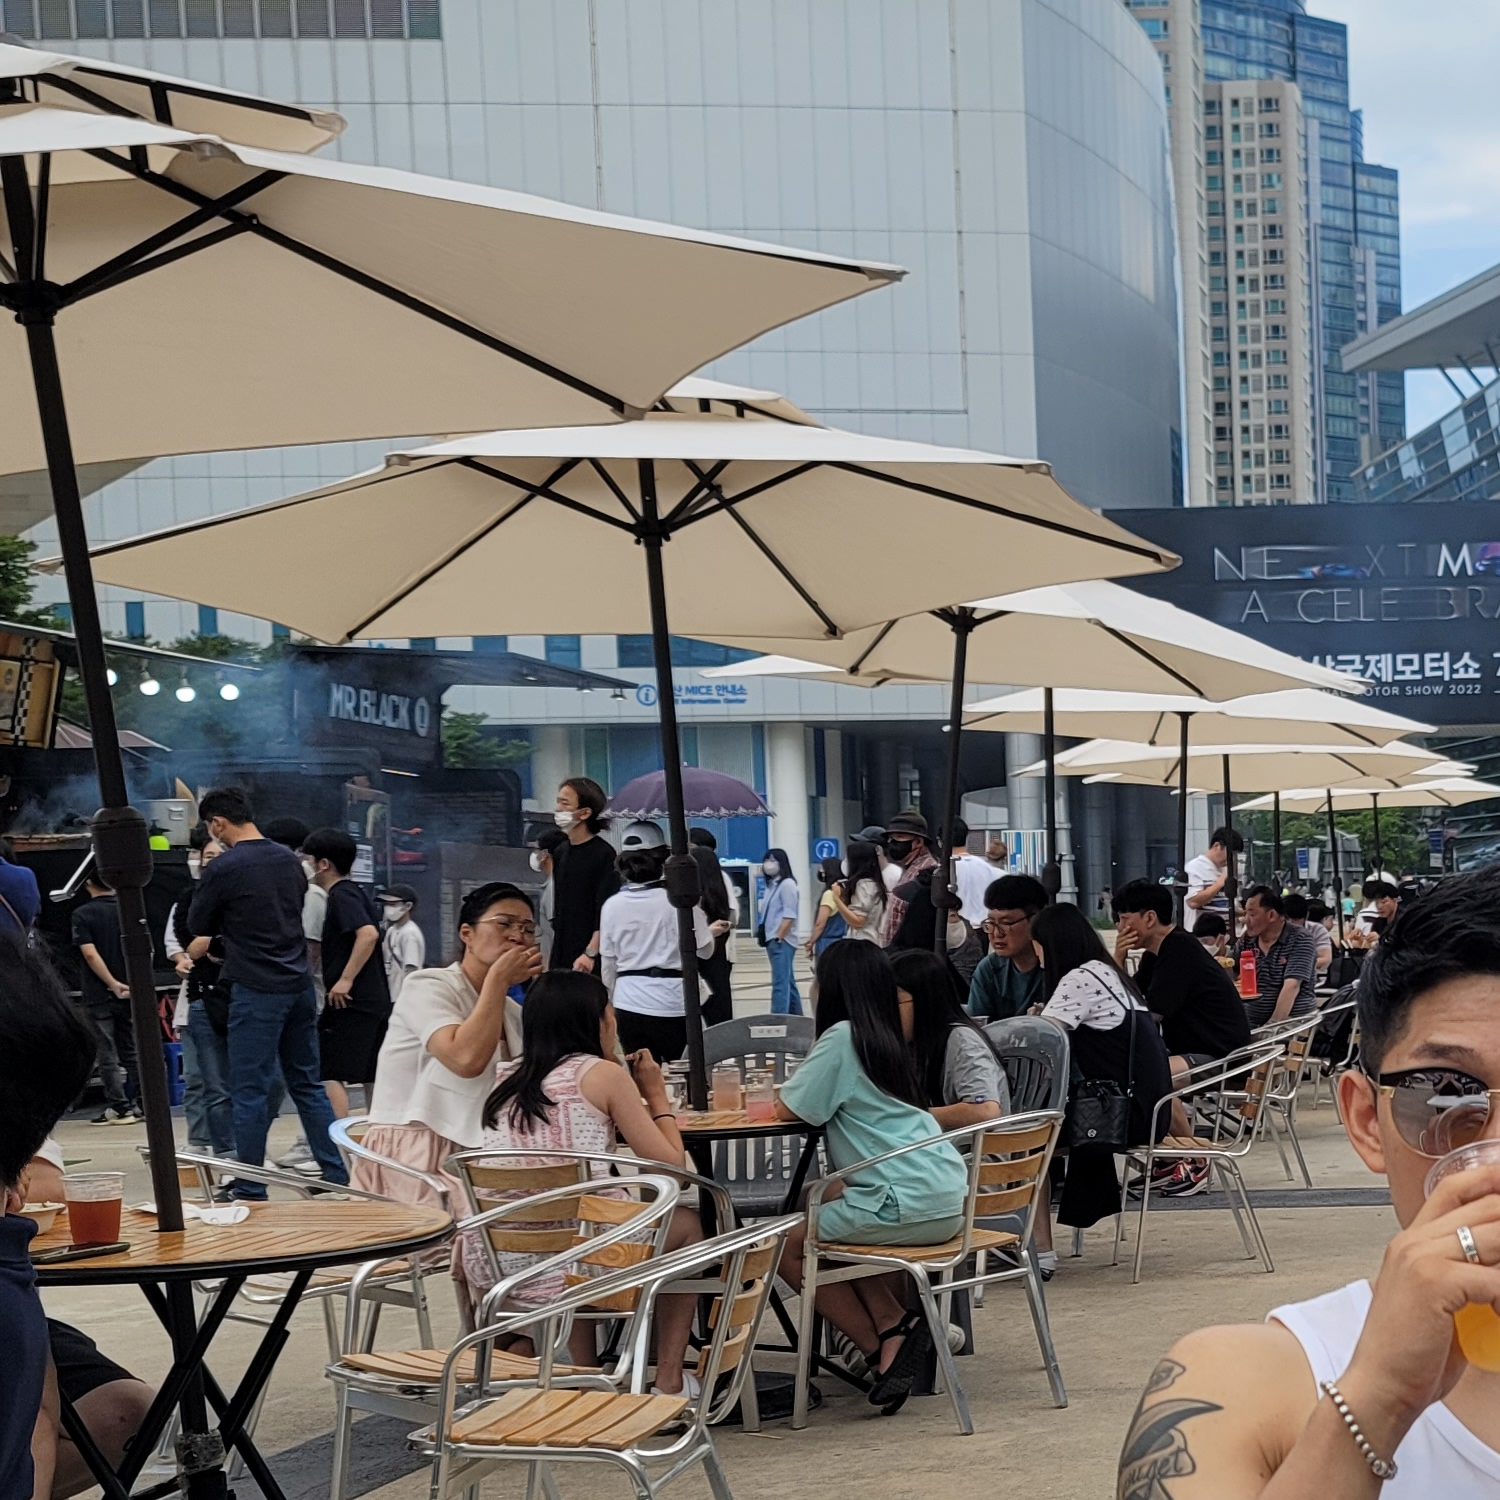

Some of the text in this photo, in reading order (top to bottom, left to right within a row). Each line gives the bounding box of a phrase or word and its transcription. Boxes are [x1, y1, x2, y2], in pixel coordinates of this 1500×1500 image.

[1241, 589, 1269, 623] A
[1296, 651, 1482, 684] 국제모터쇼
[686, 684, 714, 696] MICE
[1358, 686, 1400, 697] OTOR
[1405, 685, 1444, 696] SHOW
[1448, 684, 1482, 695] 2022
